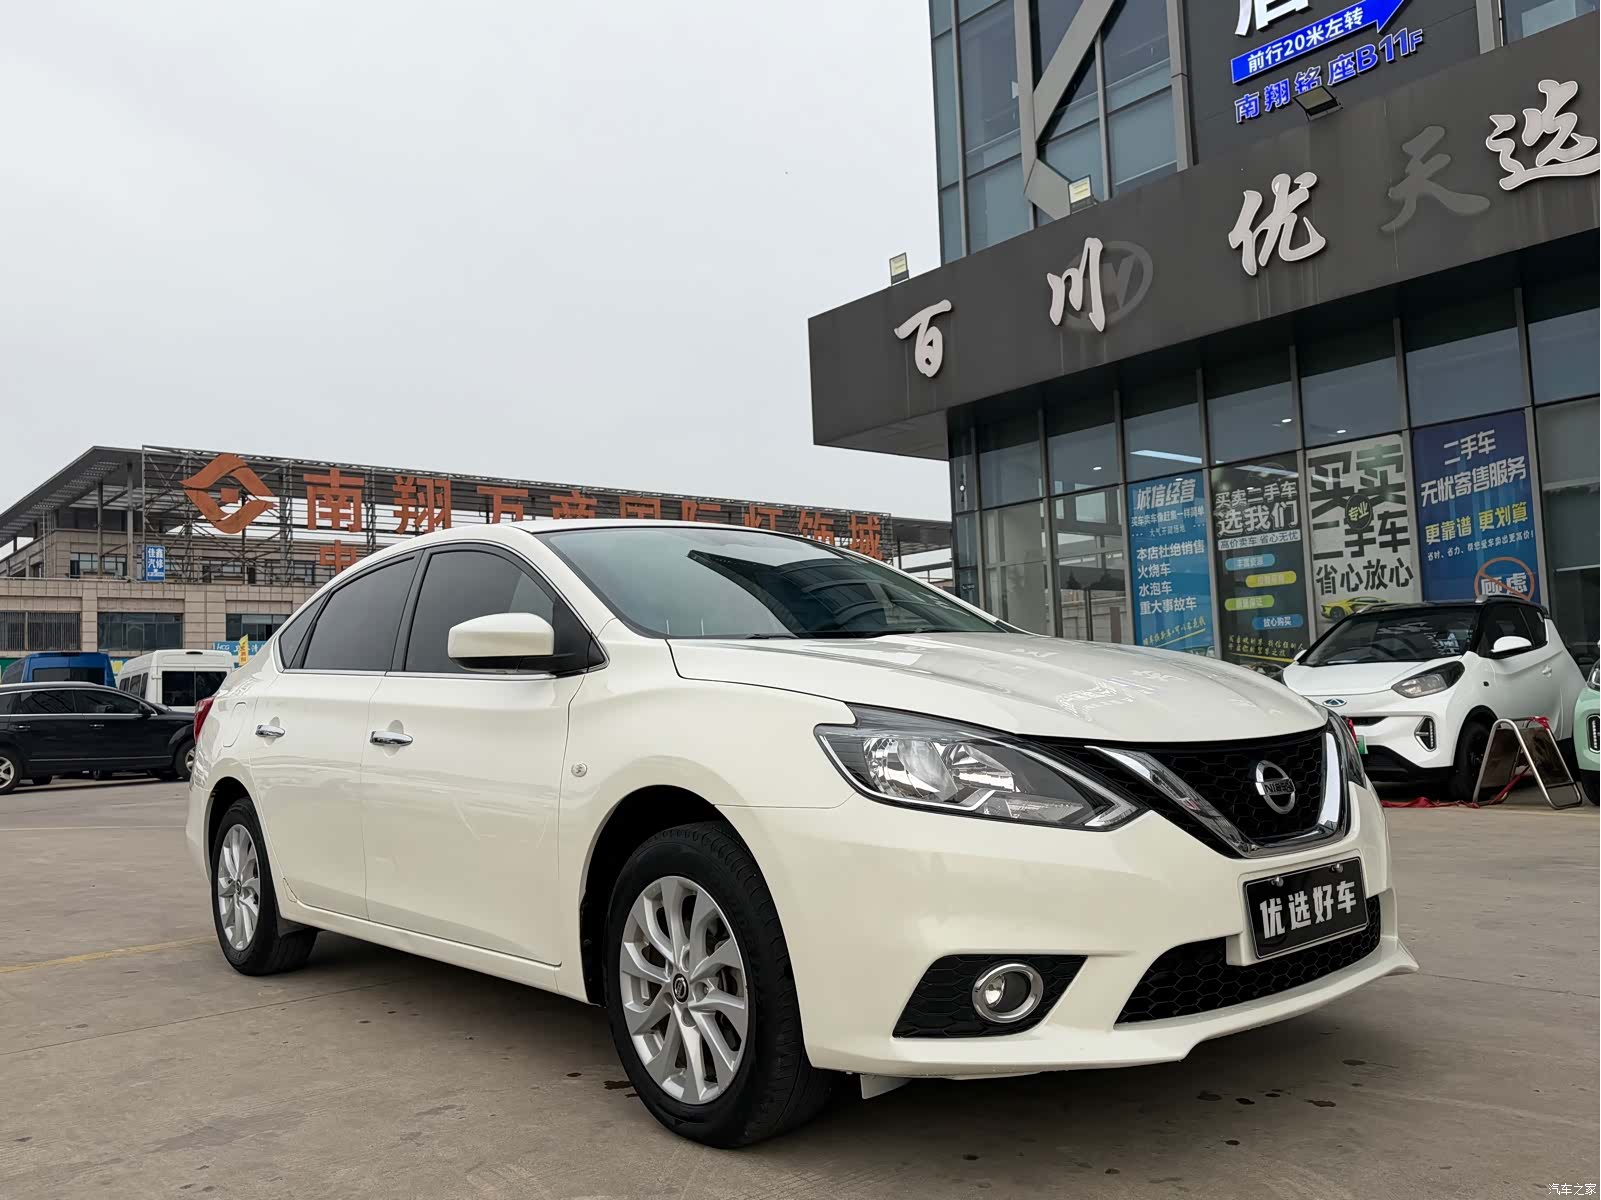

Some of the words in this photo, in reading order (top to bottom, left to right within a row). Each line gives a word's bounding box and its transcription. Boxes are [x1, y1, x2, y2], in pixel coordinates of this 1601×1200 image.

[1247, 6, 1364, 73] 前行20米左转
[1443, 428, 1497, 466] 二手车
[1136, 479, 1196, 510] 诚信经营
[1215, 480, 1297, 509] 买卖二手车
[1308, 444, 1406, 519] 买卖
[1420, 455, 1527, 508] 无忧寄售服务
[1217, 500, 1299, 536] 选我们
[1348, 501, 1370, 521] 专业
[1425, 513, 1472, 546] 更靠谱
[1478, 501, 1528, 533] 更划算
[1136, 539, 1205, 561] 本店杜绝销售
[1220, 537, 1257, 549] 高价卖车
[1260, 531, 1298, 544] 省心无忧
[1312, 510, 1411, 560] 二手车
[1137, 562, 1172, 579] 火烧车
[1315, 557, 1414, 596] 省心放心
[1138, 580, 1173, 597] 水泡车
[1140, 596, 1198, 615] 重大事故车
[1263, 616, 1292, 628] 放心购买
[1259, 880, 1357, 939] 优选好车
